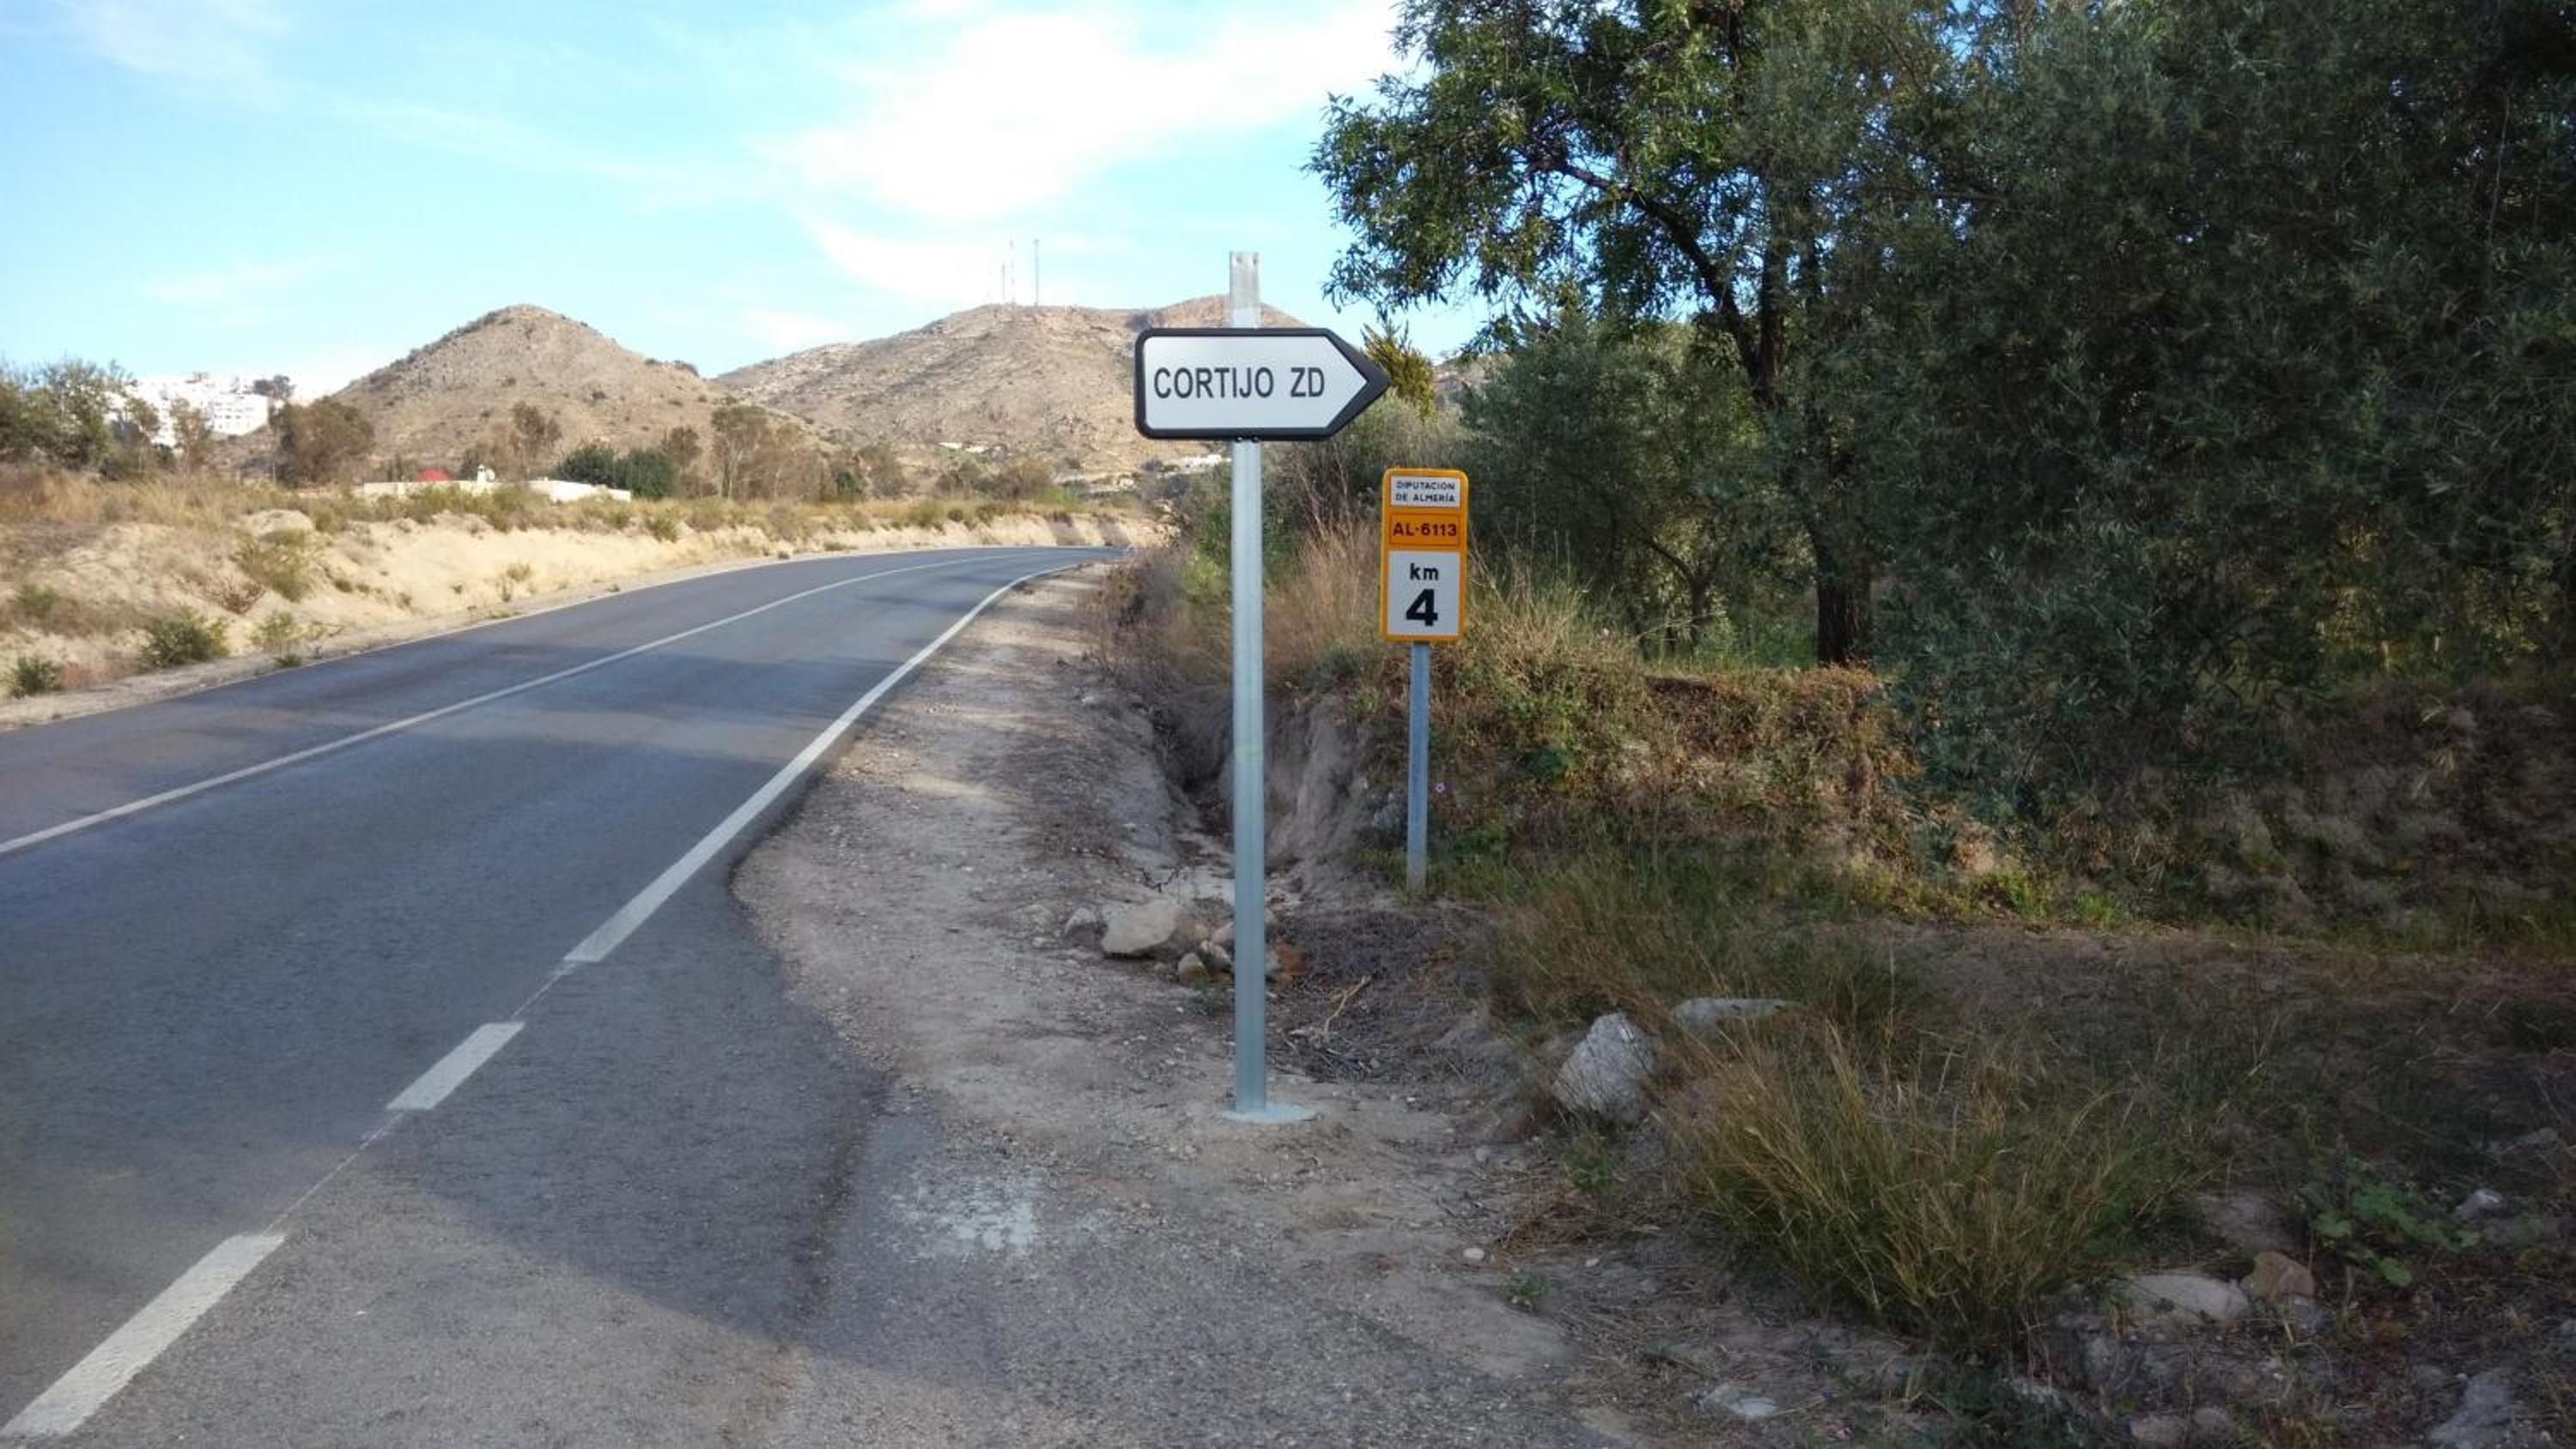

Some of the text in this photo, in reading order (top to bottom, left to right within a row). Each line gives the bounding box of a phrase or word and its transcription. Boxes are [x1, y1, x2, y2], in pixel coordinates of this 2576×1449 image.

[1153, 367, 1325, 398] CORTIJO ZD
[1395, 493, 1408, 502] DE
[1393, 522, 1457, 537] AL-6113
[1409, 563, 1438, 580] km
[1405, 588, 1438, 627] 4
